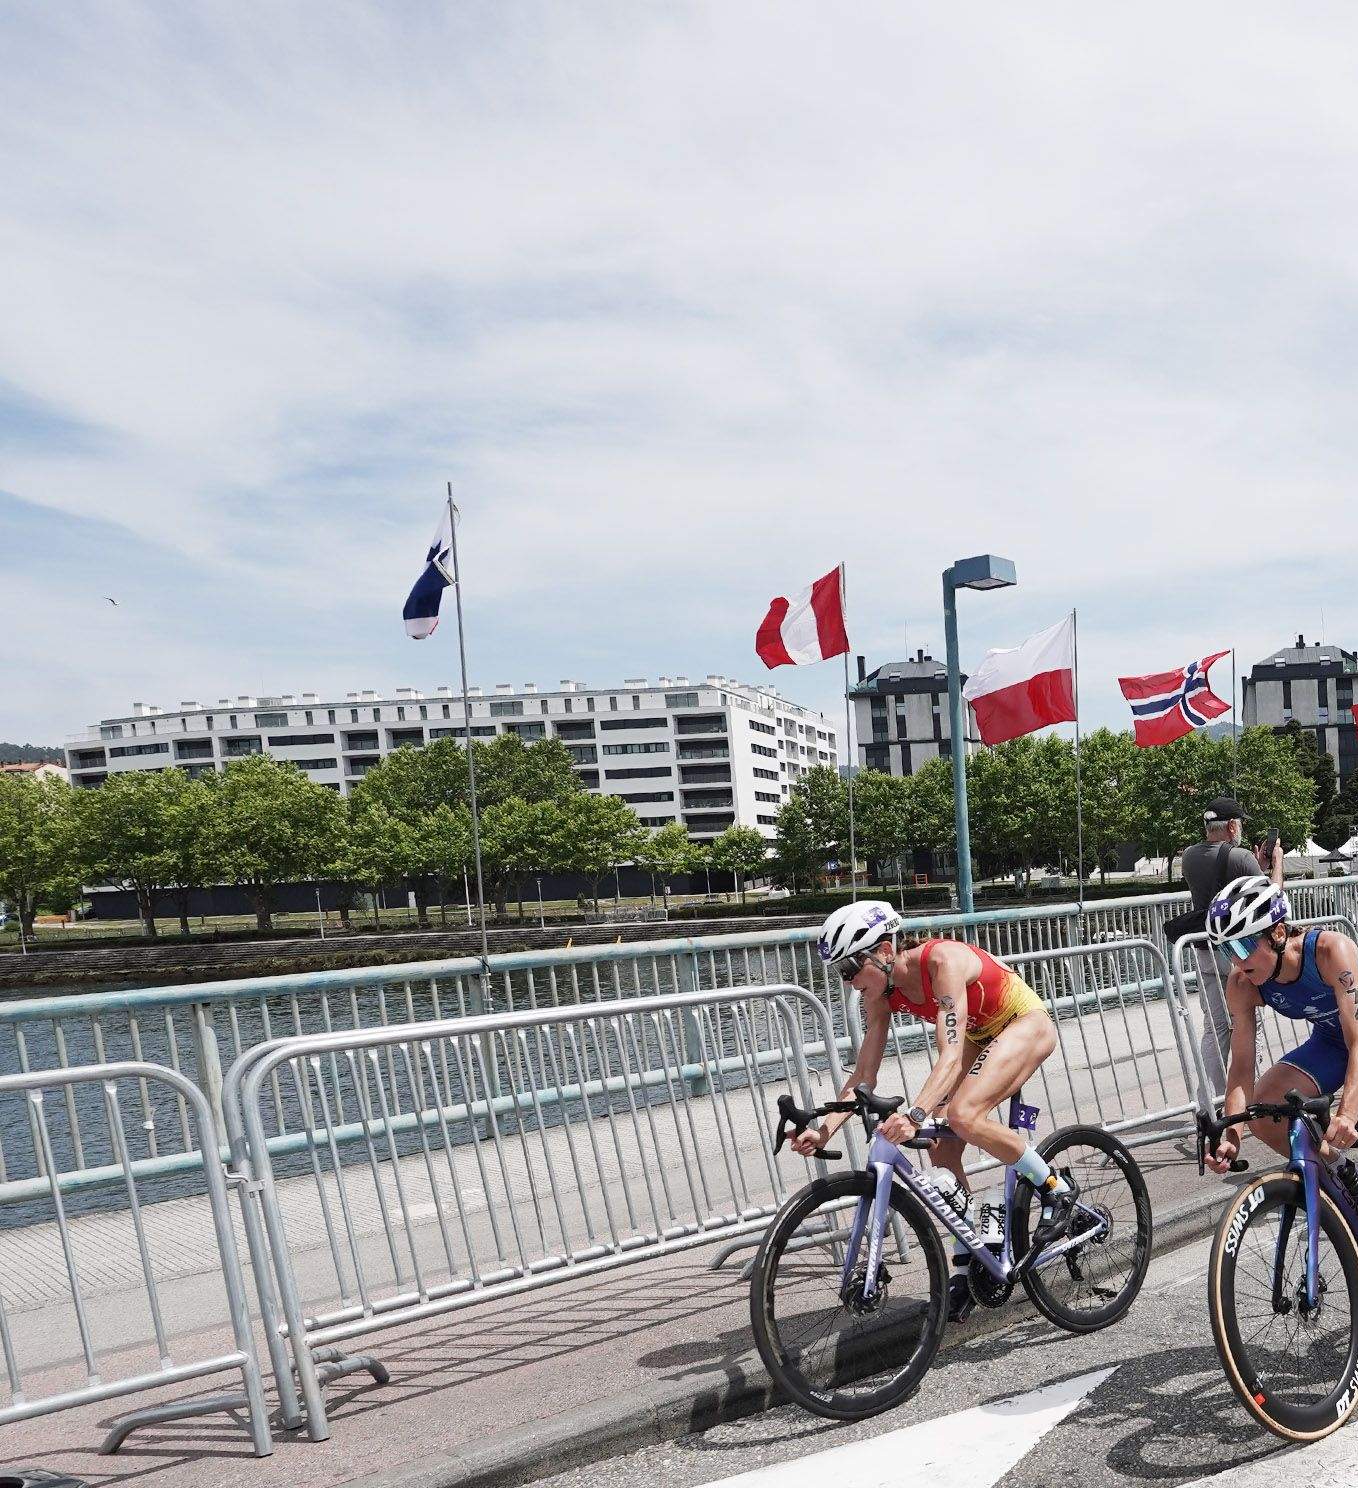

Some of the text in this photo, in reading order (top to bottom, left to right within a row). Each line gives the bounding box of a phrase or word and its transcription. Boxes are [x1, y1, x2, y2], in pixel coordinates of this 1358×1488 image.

[945, 1012, 958, 1045] 62
[908, 1167, 985, 1250] SPECIALIZED
[1225, 1185, 1265, 1258] DT SWISS
[1335, 1389, 1351, 1418] DT
